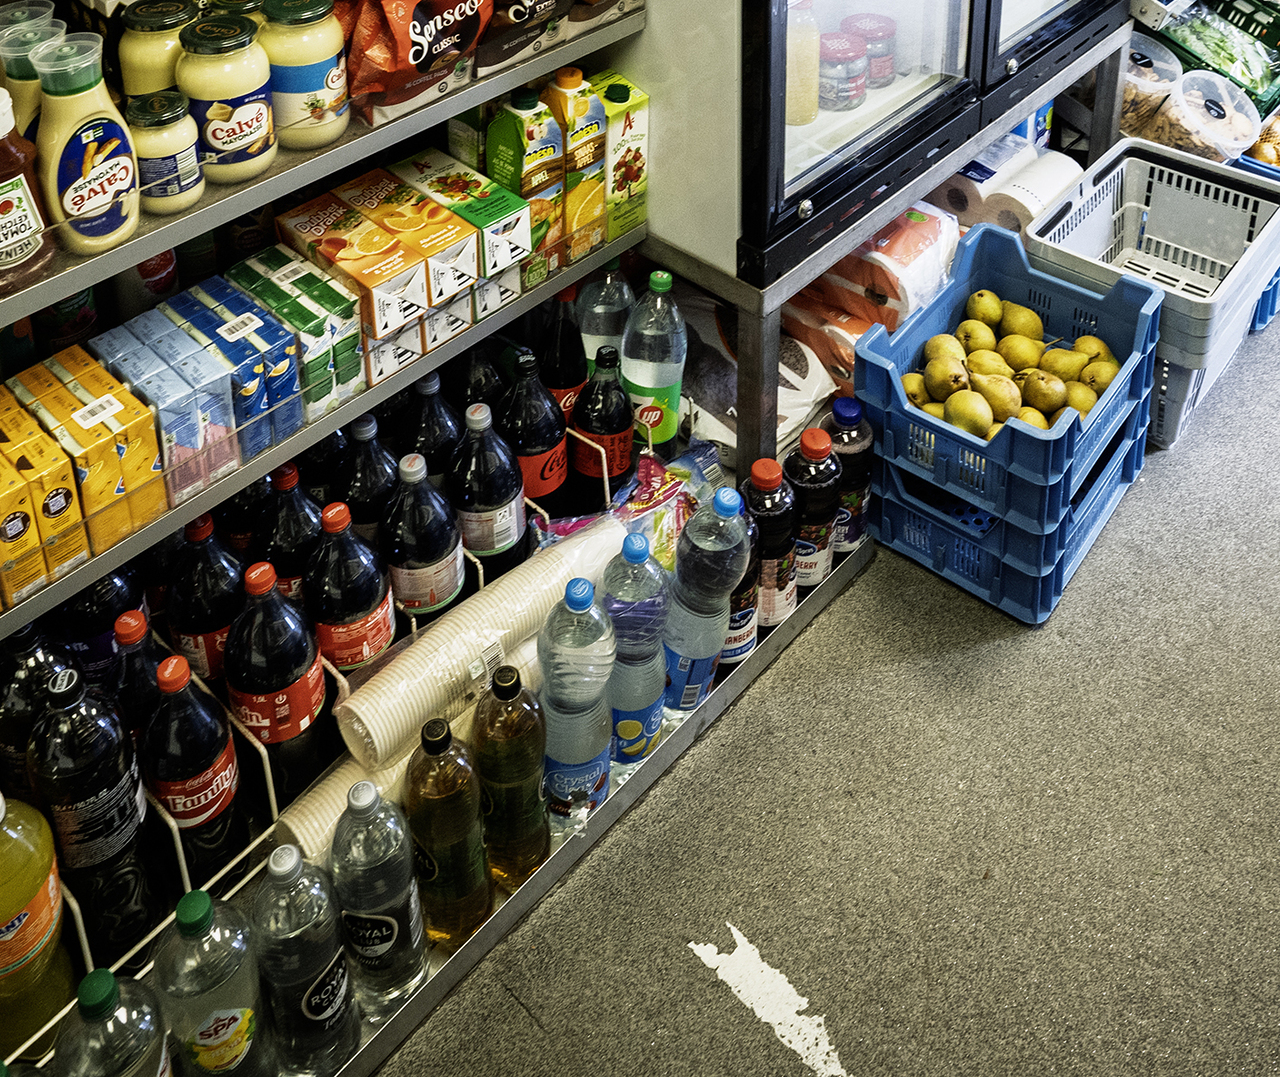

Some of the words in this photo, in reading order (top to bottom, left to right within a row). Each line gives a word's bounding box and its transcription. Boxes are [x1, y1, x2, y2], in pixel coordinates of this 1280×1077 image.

[210, 108, 265, 142] Calvé
[222, 123, 266, 148] MAYONAISE
[70, 165, 129, 213] Calvé
[71, 160, 121, 193] MAYONAISE
[351, 177, 392, 207] Dubbel
[365, 181, 399, 210] Drank
[294, 203, 339, 234] Dubbel
[311, 207, 347, 236] Drank
[167, 763, 232, 811] Family
[554, 767, 600, 785] Crystal
[196, 1013, 239, 1044] SPA
